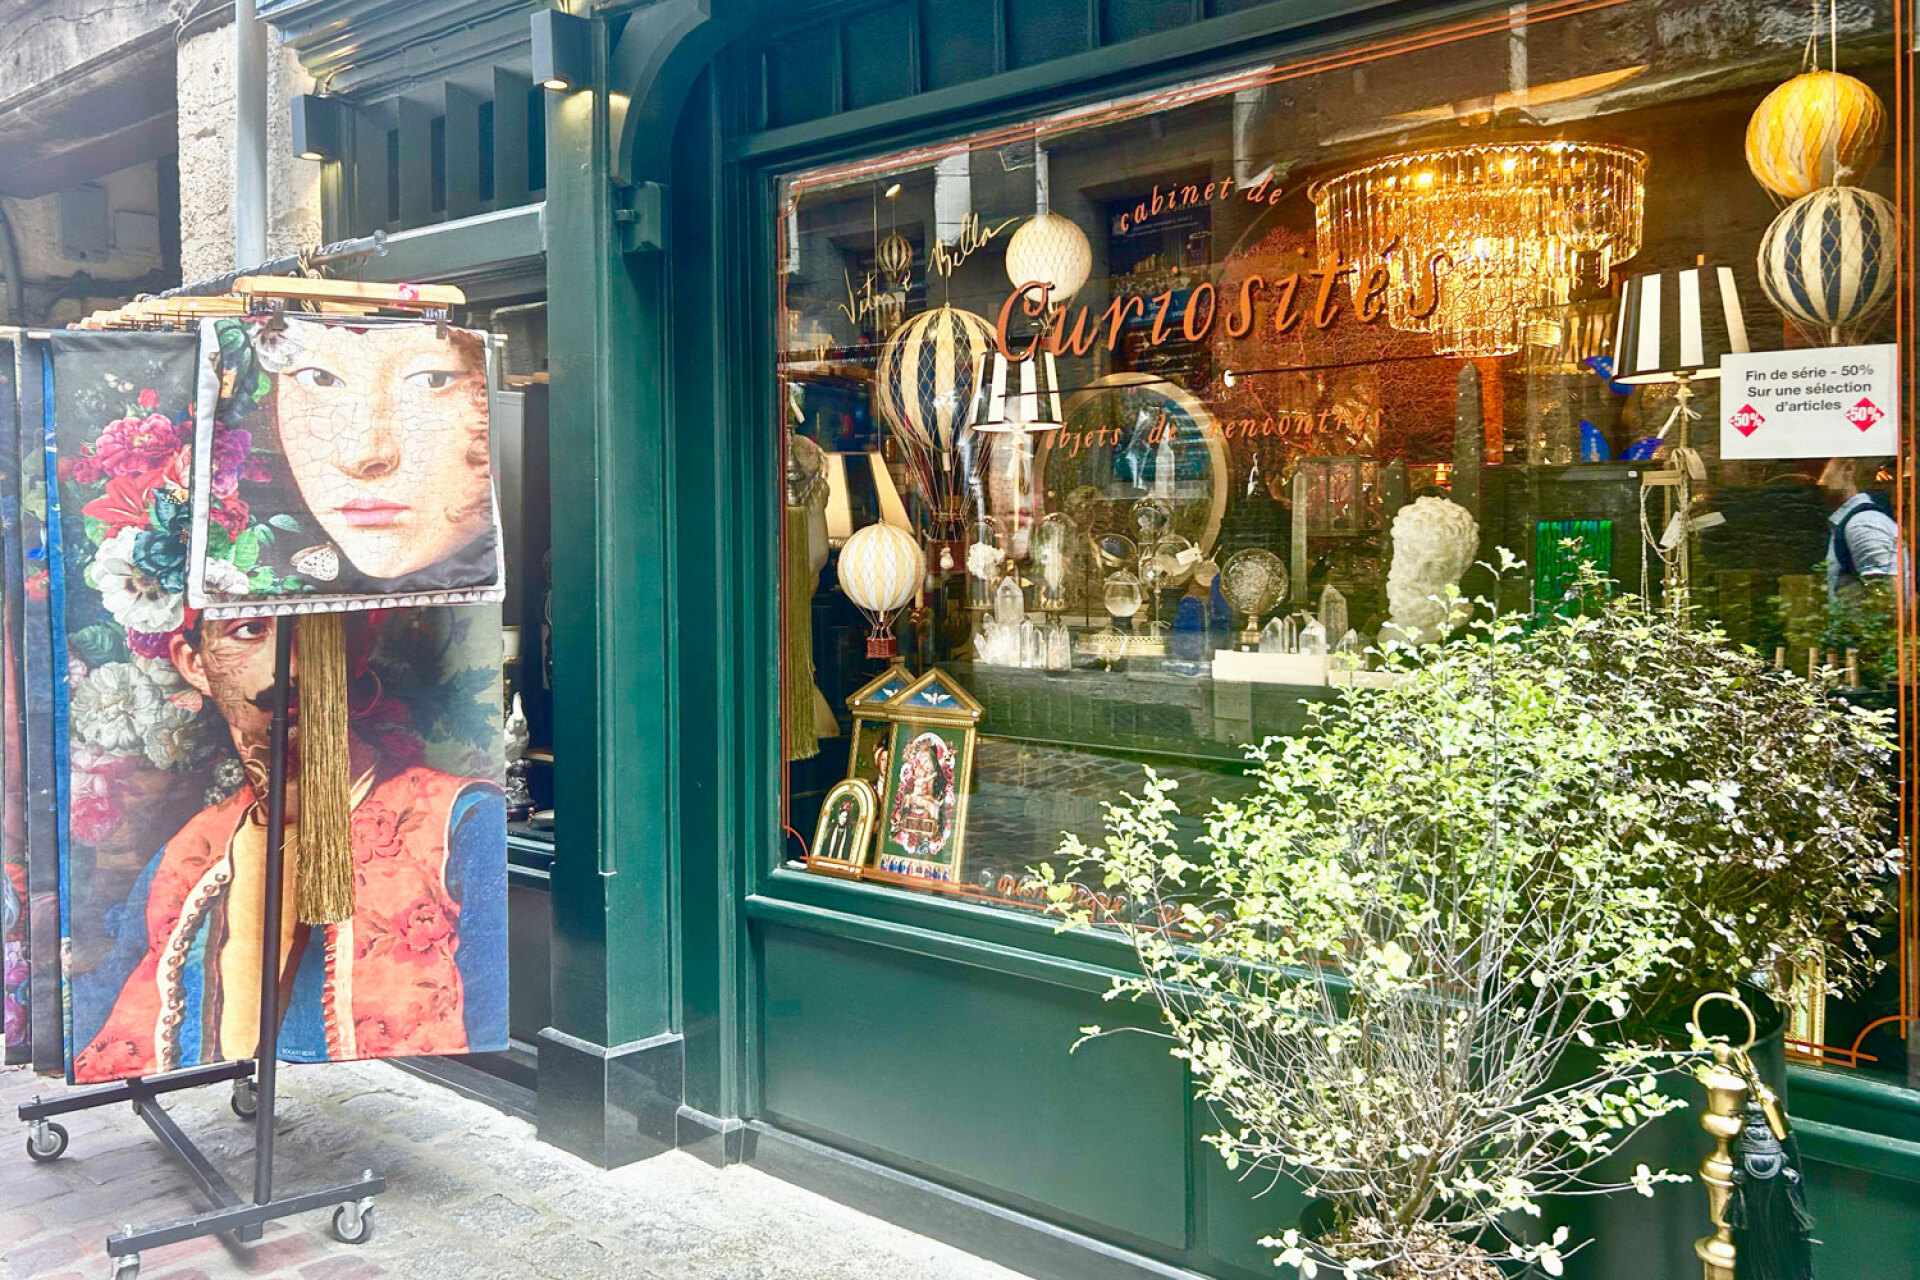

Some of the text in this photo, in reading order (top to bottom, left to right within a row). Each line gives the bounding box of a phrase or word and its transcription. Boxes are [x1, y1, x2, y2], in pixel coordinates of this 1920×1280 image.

[1120, 172, 1283, 232] cabinet de
[997, 235, 1453, 362] Curiosités
[1746, 369, 1766, 381] Fin
[1770, 369, 1788, 380] de
[1792, 367, 1826, 379] série
[1841, 364, 1874, 376] 50%
[1747, 381, 1872, 397] Sur une sélection
[1775, 400, 1842, 413] d'articles
